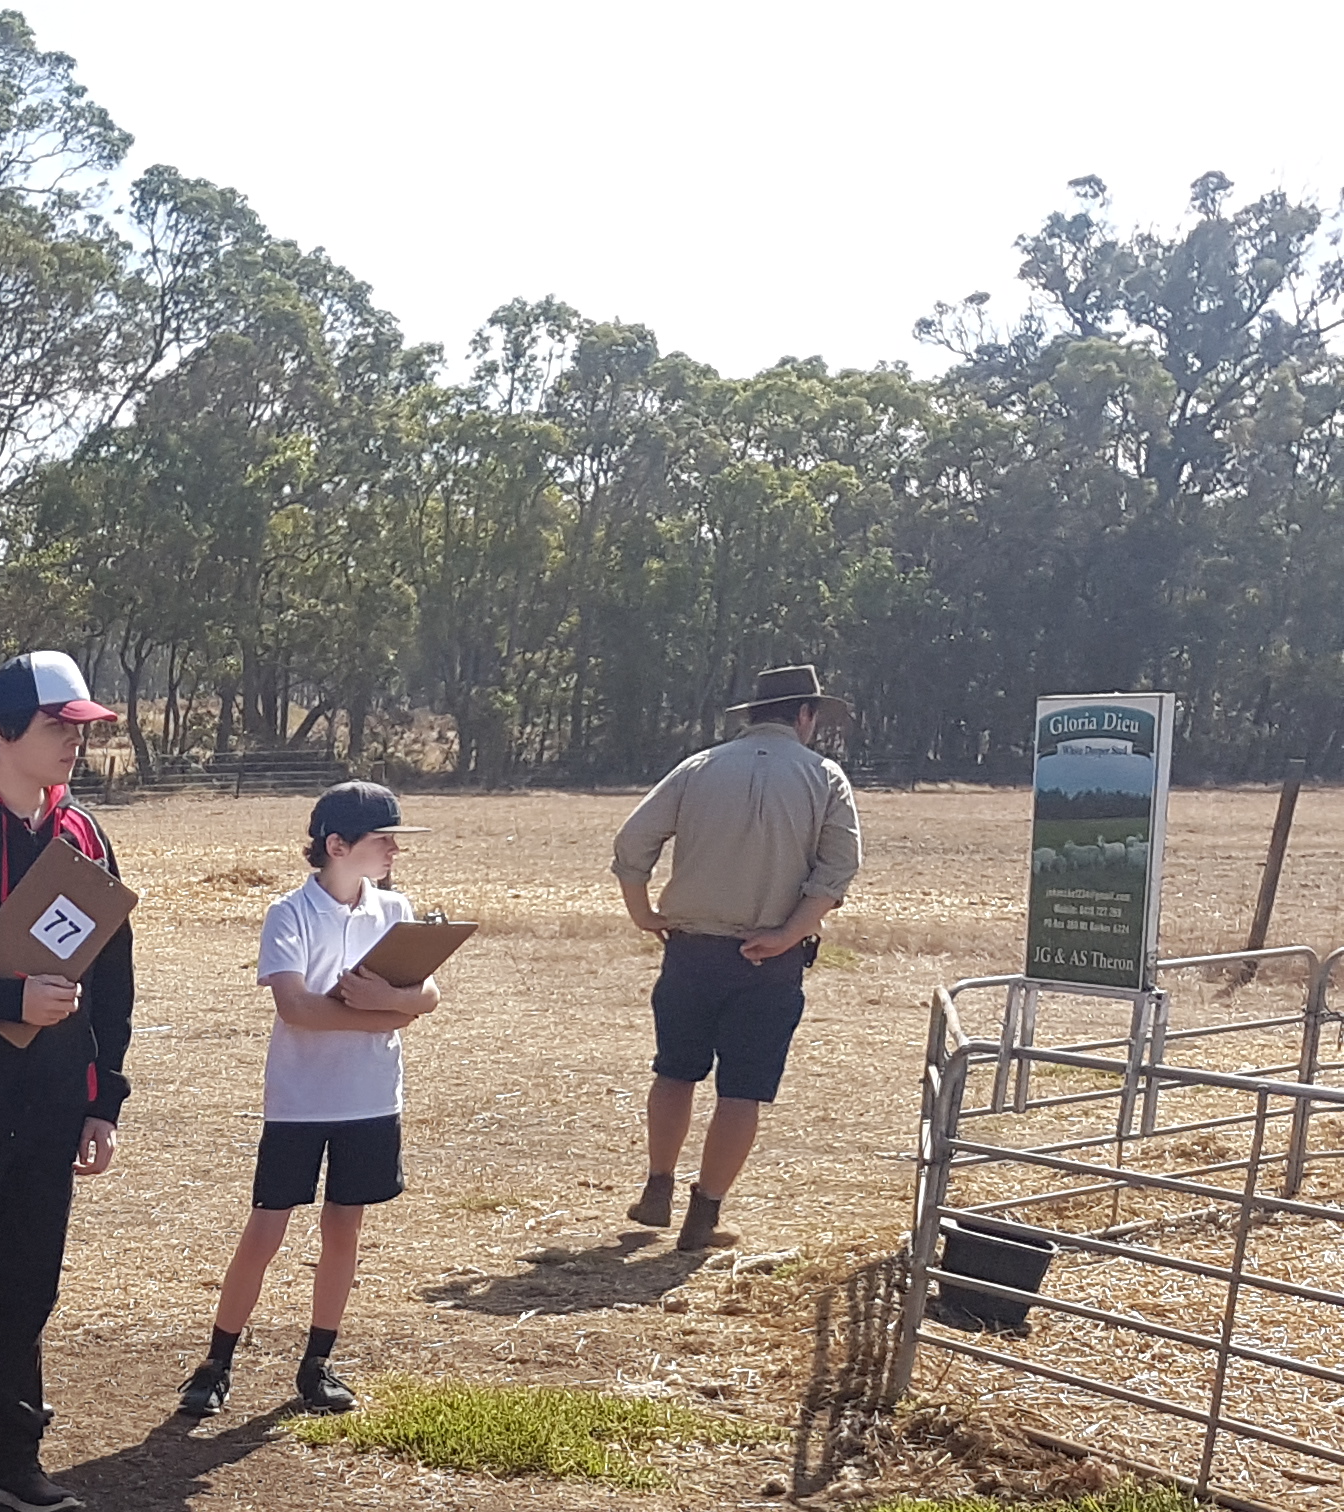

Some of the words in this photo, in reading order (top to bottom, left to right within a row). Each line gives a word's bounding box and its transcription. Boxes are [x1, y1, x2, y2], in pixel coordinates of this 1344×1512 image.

[1049, 712, 1097, 735] Gloria
[1102, 711, 1140, 733] Dieu
[43, 908, 82, 944] 77
[1033, 946, 1051, 963] JG
[1054, 947, 1066, 965] &
[1069, 949, 1088, 967] AS
[1091, 951, 1134, 971] Theron
